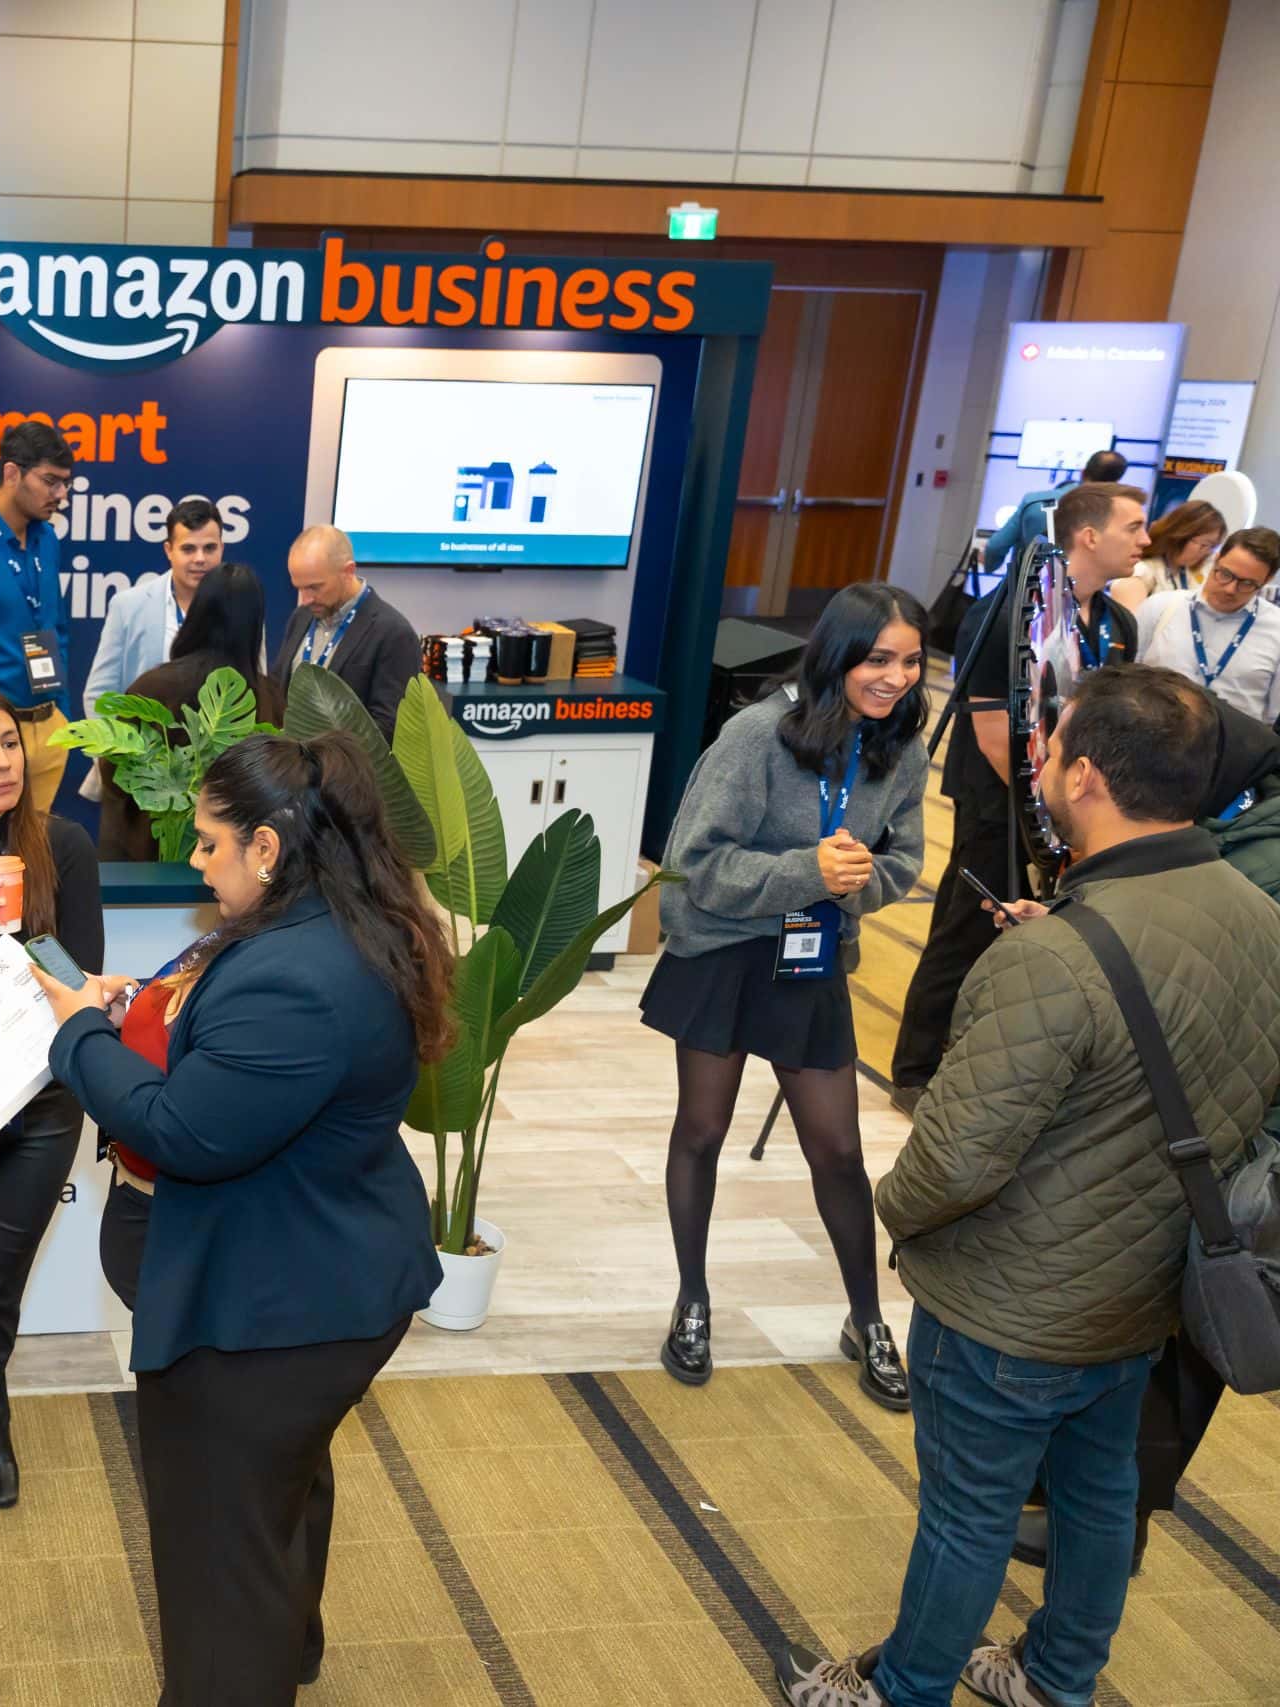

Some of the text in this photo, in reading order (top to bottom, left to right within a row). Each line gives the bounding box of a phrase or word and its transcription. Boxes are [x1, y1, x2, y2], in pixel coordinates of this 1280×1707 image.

[321, 237, 696, 332] business
[463, 697, 653, 720] amazon business
